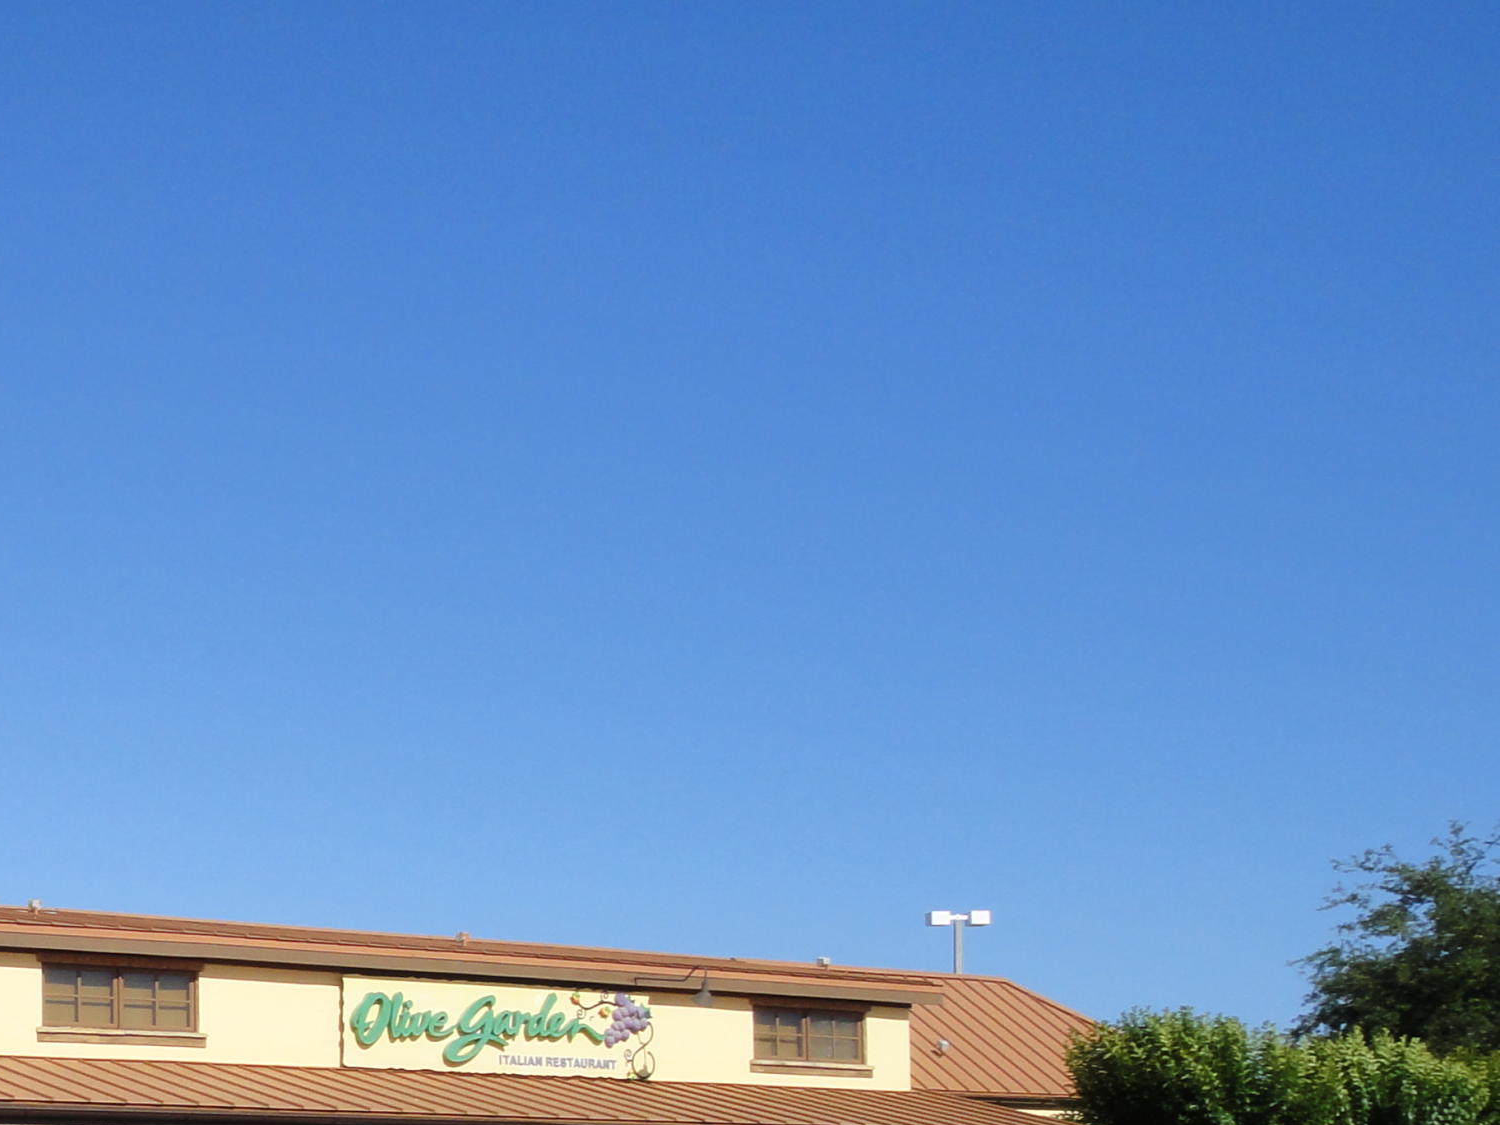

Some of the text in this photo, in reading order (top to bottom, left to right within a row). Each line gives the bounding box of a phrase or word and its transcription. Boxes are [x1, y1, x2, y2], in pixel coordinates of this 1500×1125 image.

[351, 991, 606, 1064] Olive Garden
[499, 1055, 617, 1070] ITALIAN RESTAURANT
